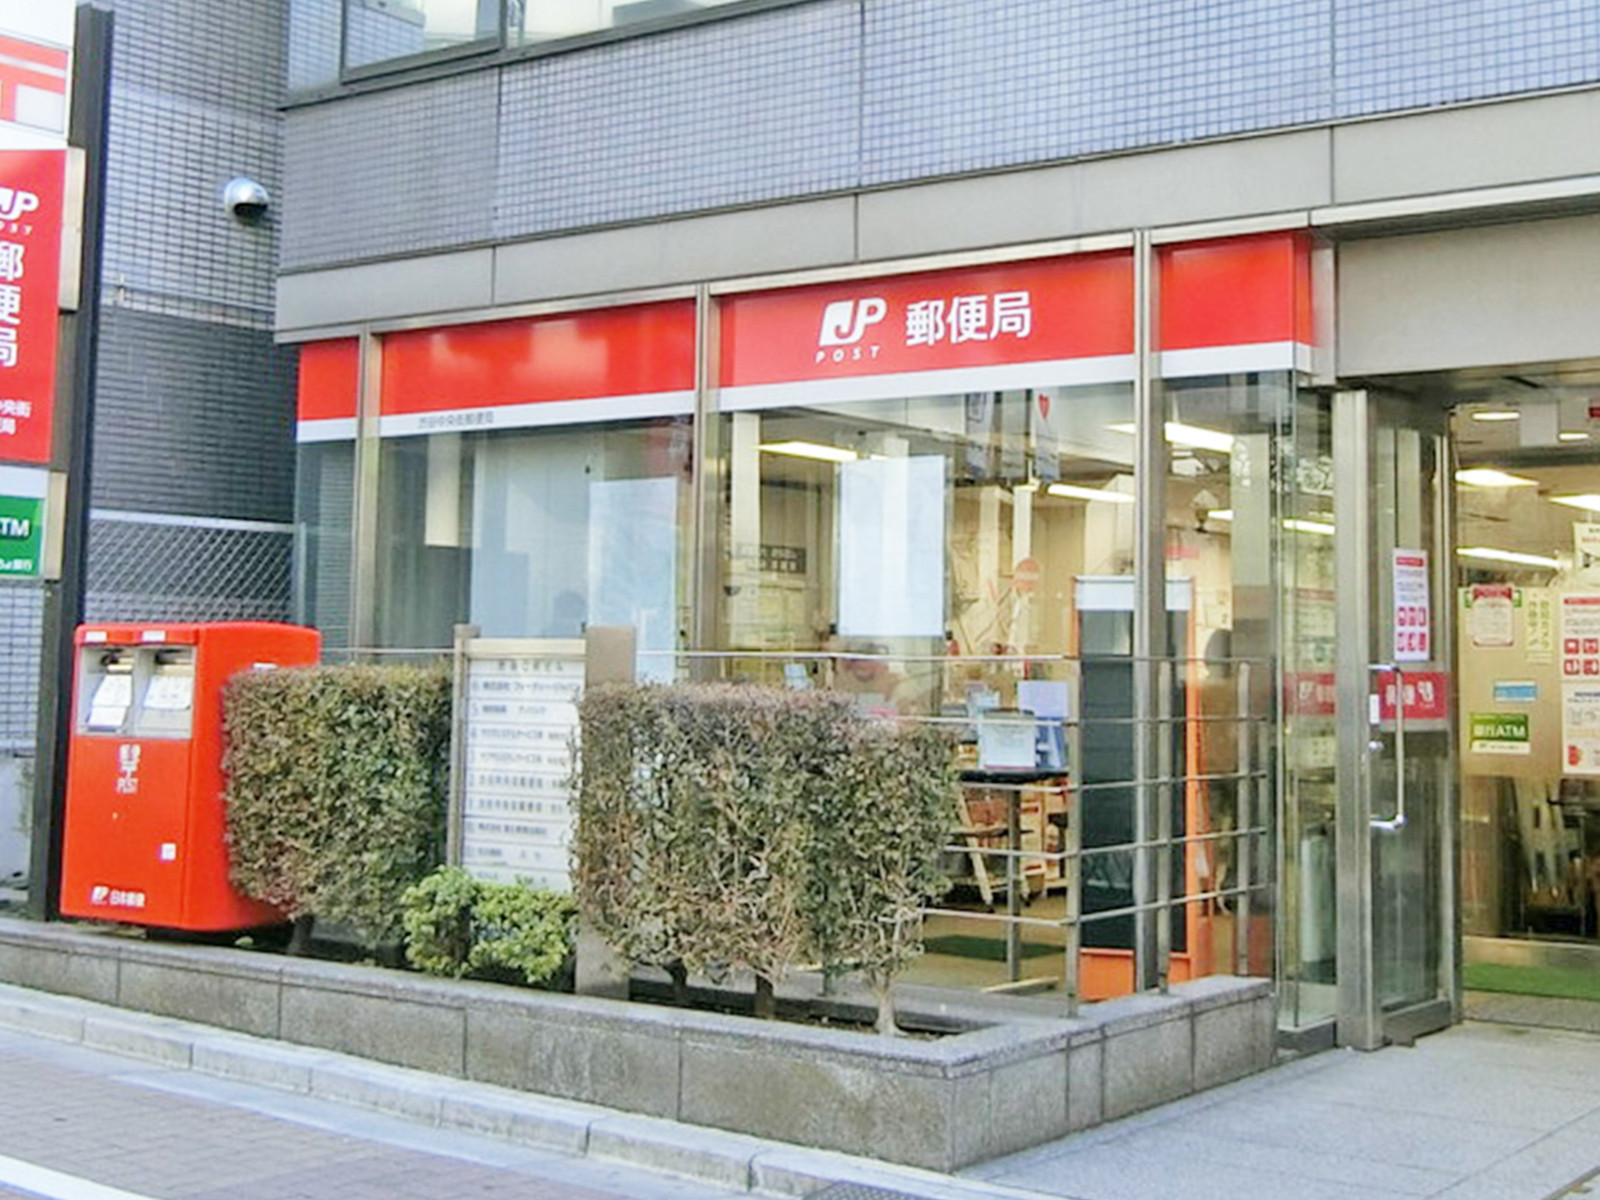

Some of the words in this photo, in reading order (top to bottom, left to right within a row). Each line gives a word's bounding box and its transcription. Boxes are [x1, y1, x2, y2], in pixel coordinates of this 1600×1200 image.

[905, 291, 1032, 346] 郵便局
[815, 345, 881, 364] POST
[0, 517, 30, 537] TM
